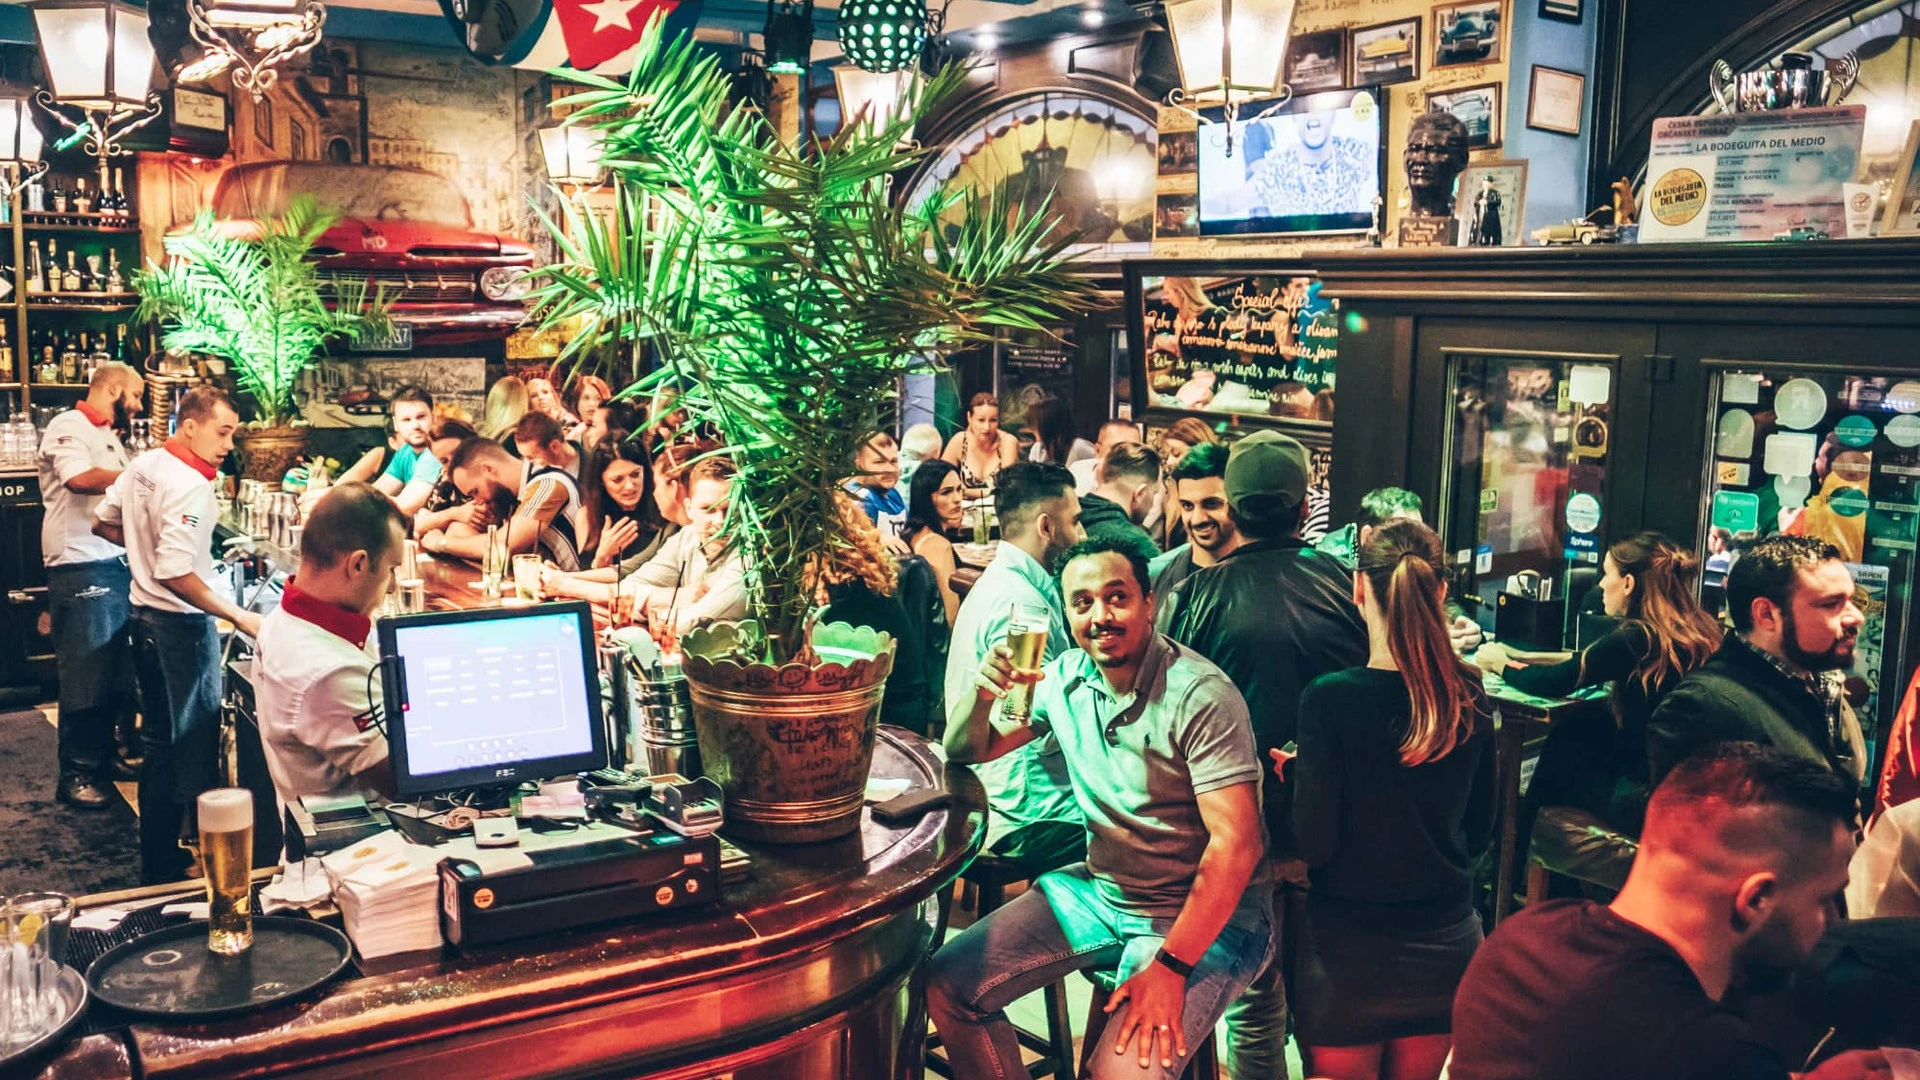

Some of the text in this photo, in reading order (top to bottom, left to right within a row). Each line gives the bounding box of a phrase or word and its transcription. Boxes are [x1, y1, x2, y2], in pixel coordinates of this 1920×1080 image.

[1696, 143, 1708, 152] LA
[1710, 139, 1767, 151] BODEGUITA
[1769, 138, 1788, 149] DEL
[1790, 136, 1826, 147] MEDIO
[1654, 180, 1703, 198] LA BODEGUITA
[1660, 196, 1674, 206] DEL
[1675, 191, 1699, 203] MEDIO
[1232, 282, 1279, 317] Special
[0, 485, 25, 496] OP
